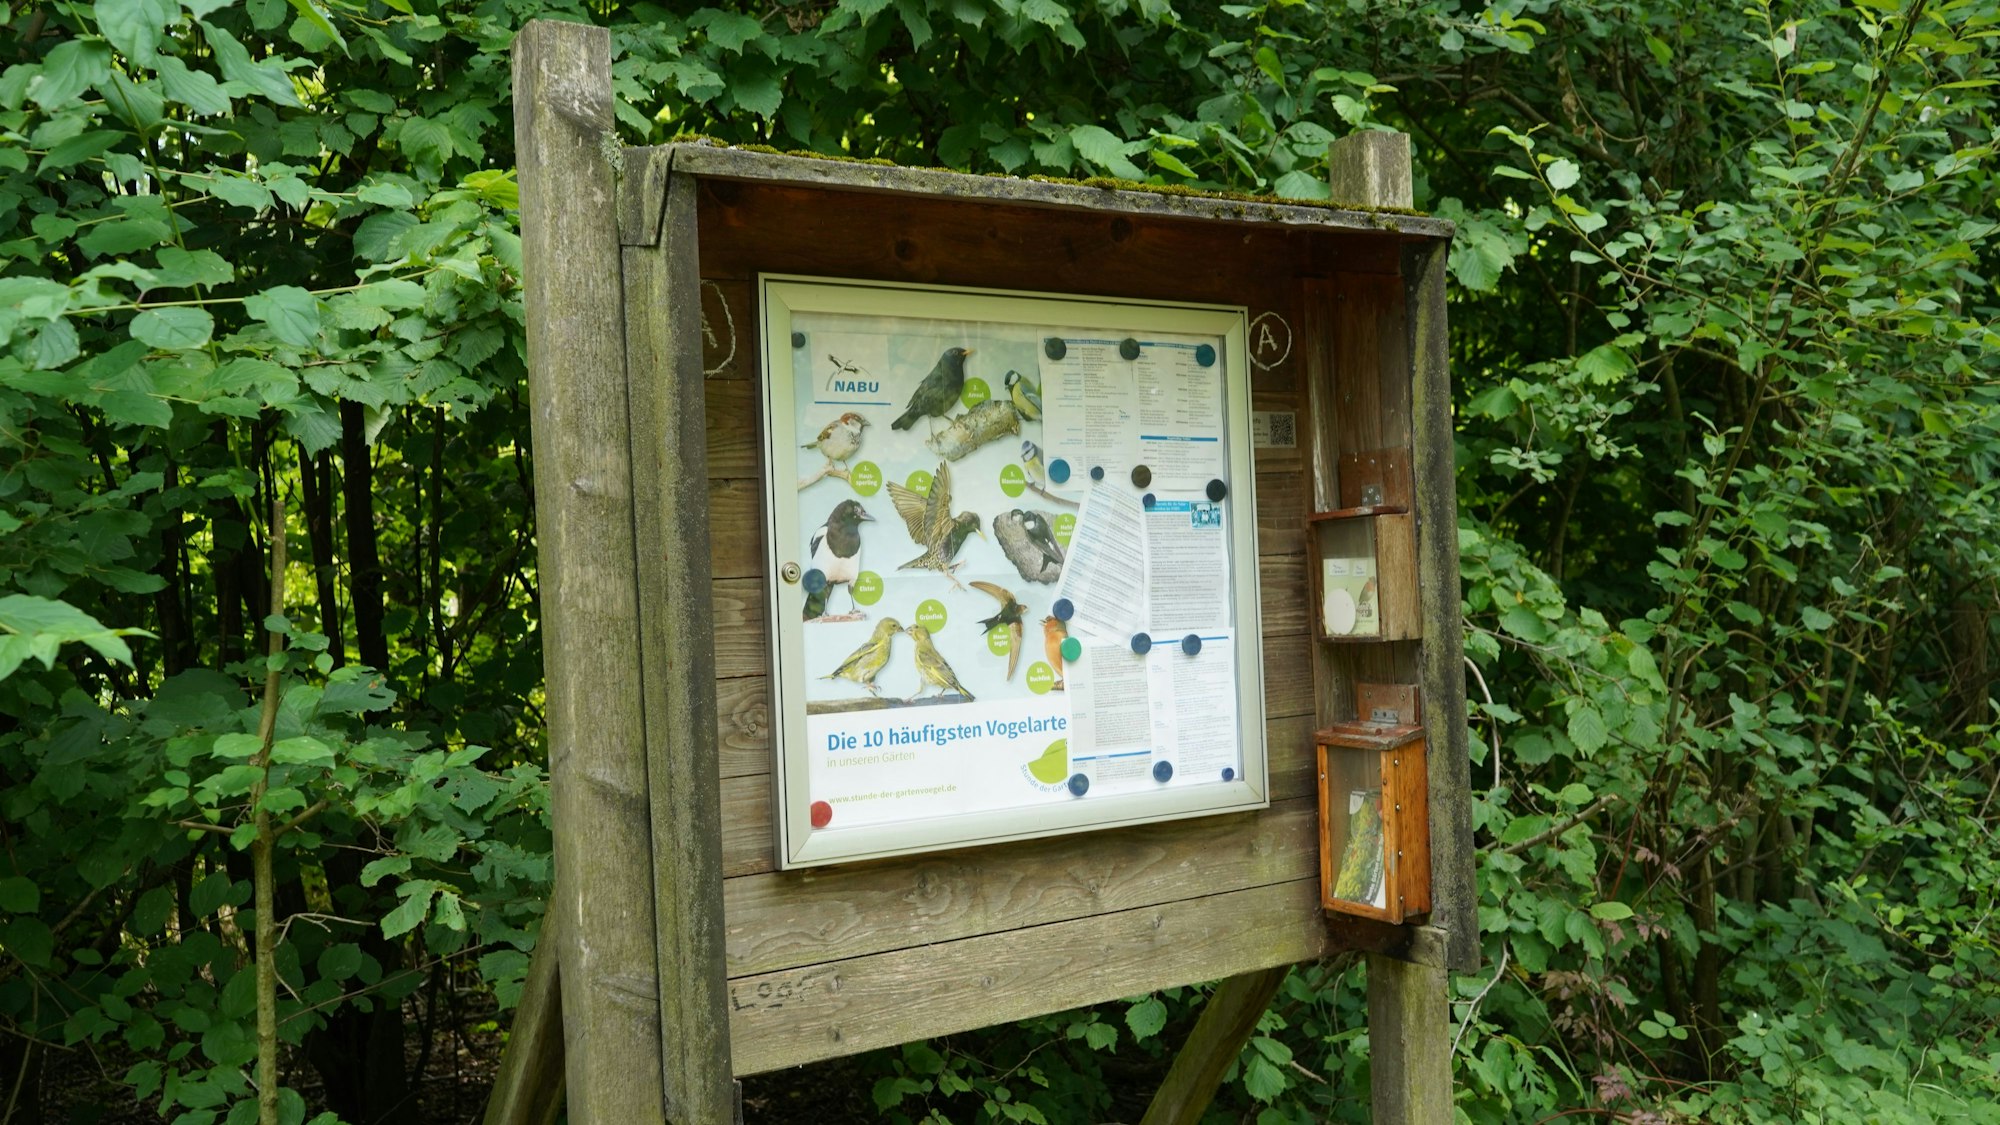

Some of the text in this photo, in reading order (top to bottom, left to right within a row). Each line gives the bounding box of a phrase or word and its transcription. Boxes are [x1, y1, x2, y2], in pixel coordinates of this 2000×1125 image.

[1257, 322, 1278, 354] A
[834, 380, 880, 393] NABU
[919, 611, 944, 621] Grünfink
[827, 715, 1067, 751] Die 10 häufigsten Vogelarte
[827, 750, 915, 768] in unseren Gärten
[1020, 764, 1068, 793] Stunde der Gart
[828, 784, 957, 805] www.stunde-der-gartenvoegel.de
